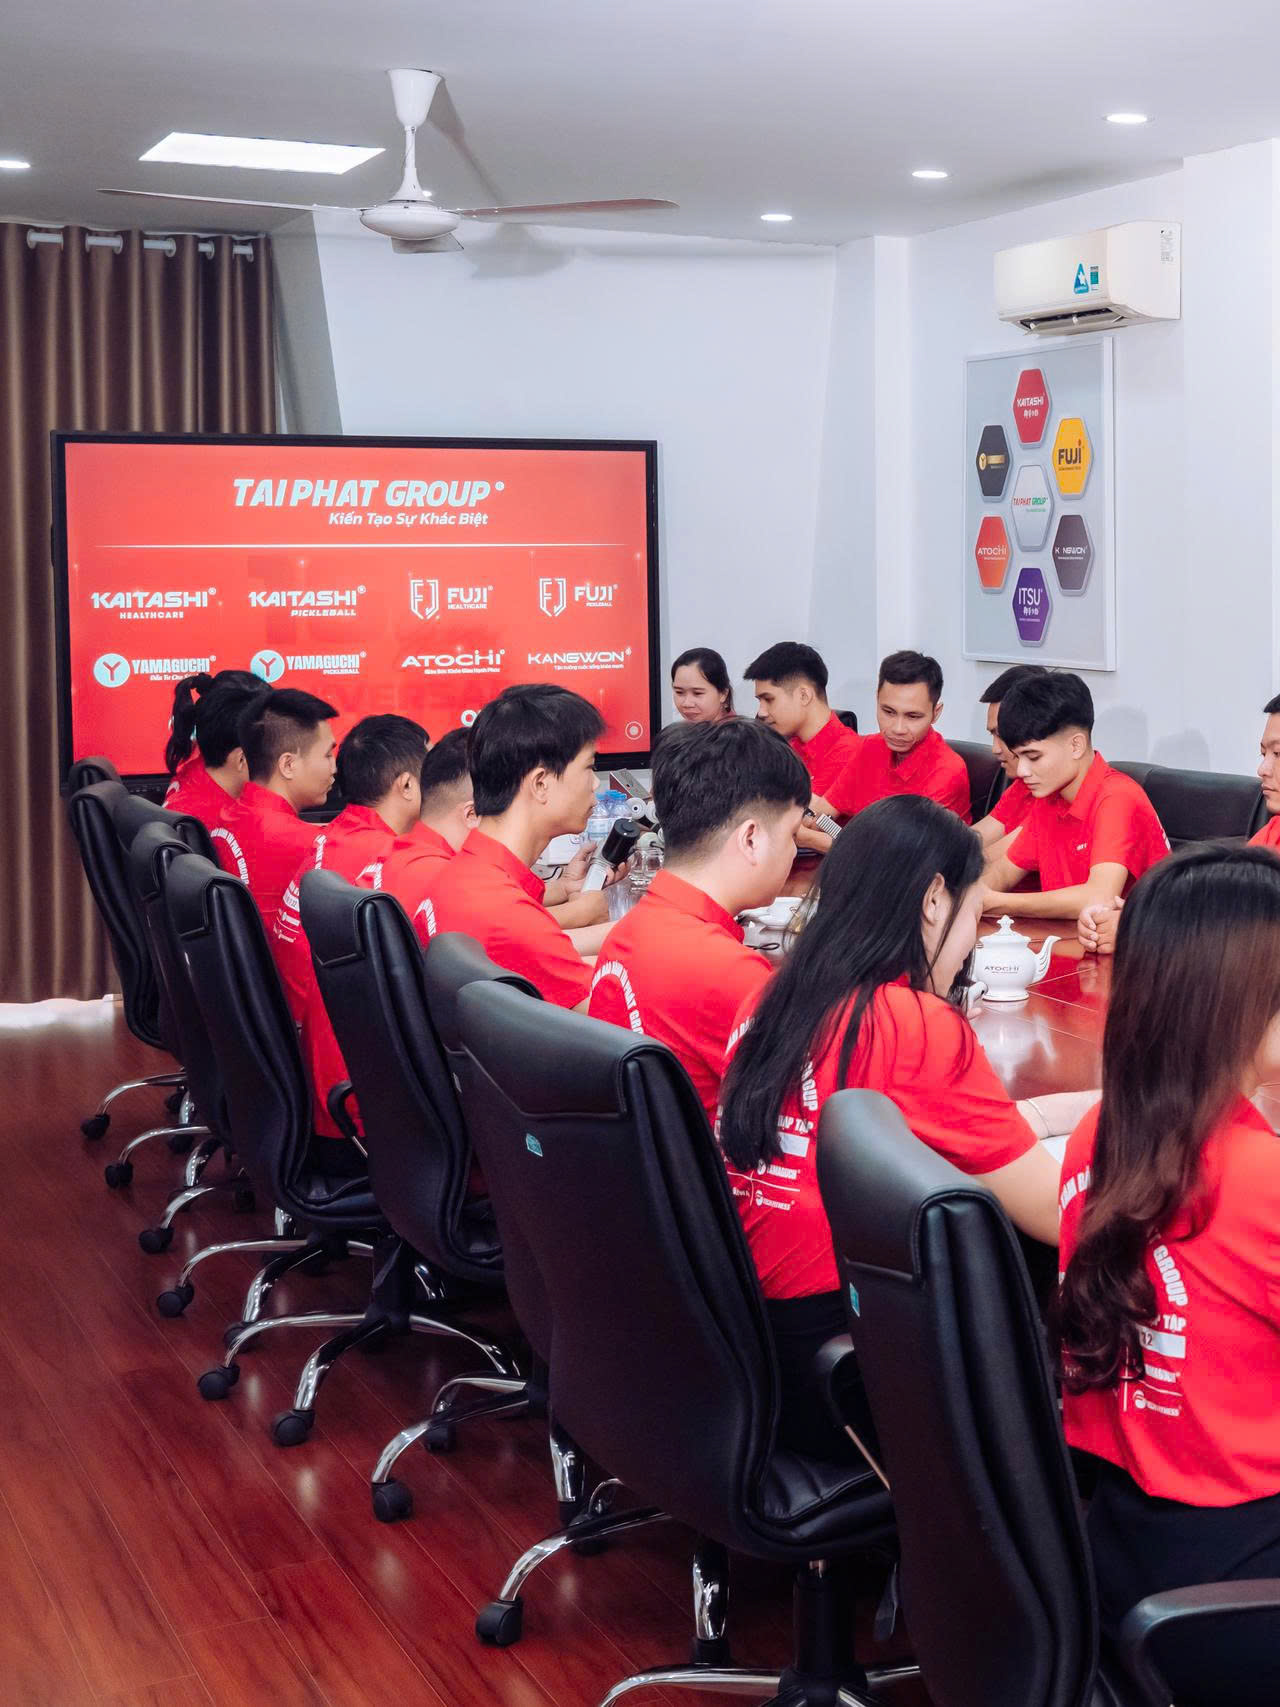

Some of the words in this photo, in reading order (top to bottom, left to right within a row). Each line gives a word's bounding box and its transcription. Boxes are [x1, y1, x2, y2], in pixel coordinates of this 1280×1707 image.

[1058, 440, 1082, 465] FUJI
[385, 480, 491, 507] GROUP
[329, 512, 363, 525] Kiến
[367, 512, 392, 527] Tạo
[396, 512, 417, 527] Sự
[420, 512, 456, 525] Khác
[458, 512, 488, 528] Biệt
[91, 591, 209, 608] KAITASHI
[248, 590, 358, 607] KAITASHI
[447, 587, 488, 603] FUJI
[574, 585, 613, 601] FUJI
[1018, 588, 1041, 605] ITSU
[119, 611, 184, 619] HEALTHCARE
[131, 657, 210, 674] YAMAGUCHI
[286, 654, 360, 671] YAMAGUCHI
[401, 650, 501, 667] ATOCHI
[528, 651, 625, 665] KANGWON
[1154, 1245, 1188, 1306] GROUP
